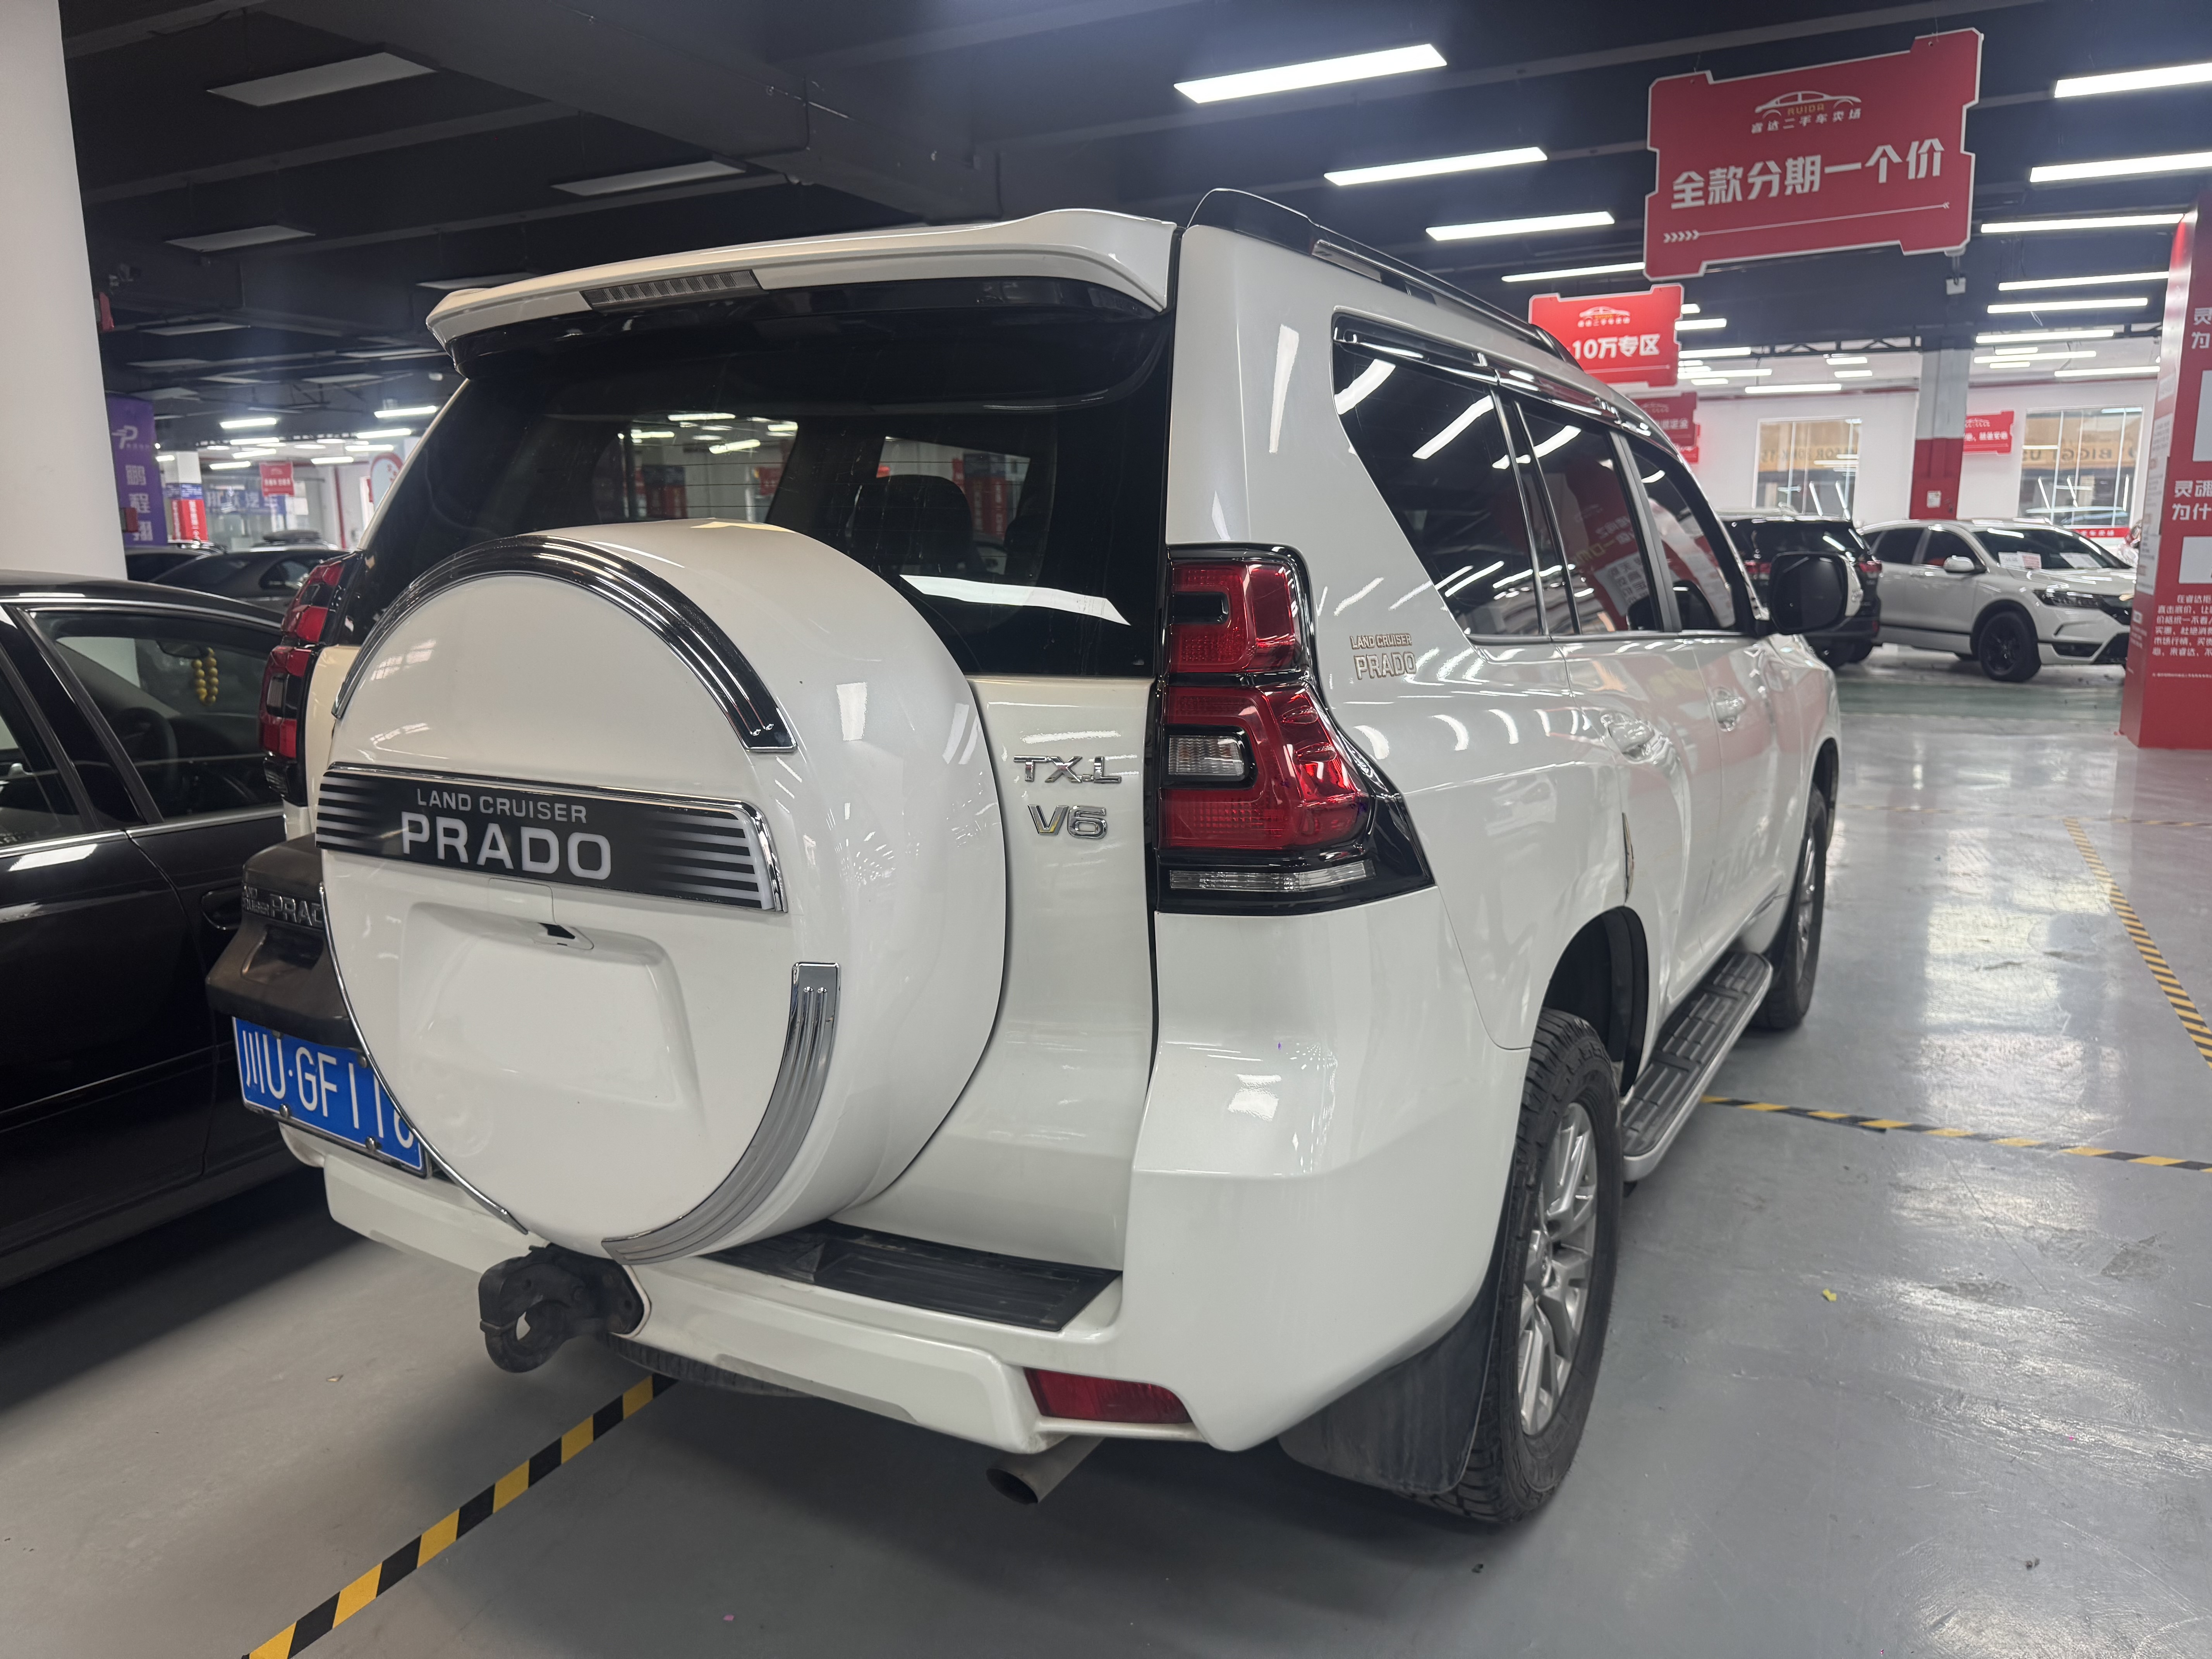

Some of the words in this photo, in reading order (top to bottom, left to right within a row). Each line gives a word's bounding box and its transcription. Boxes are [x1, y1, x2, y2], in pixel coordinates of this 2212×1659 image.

[1788, 103, 1825, 115] RUIDA
[1671, 138, 1945, 210] 全款分期一个价
[1572, 333, 1661, 359] 10万专区
[2191, 331, 2210, 349] 为
[2172, 503, 2212, 520] 为什
[1350, 635, 1375, 649] LAND
[1375, 633, 1412, 647] CRUISER
[1354, 651, 1417, 680] PRADO
[417, 788, 472, 811] LAND
[480, 796, 587, 824] CRUISER
[1028, 804, 1108, 839] V6
[401, 811, 612, 881] PRADO
